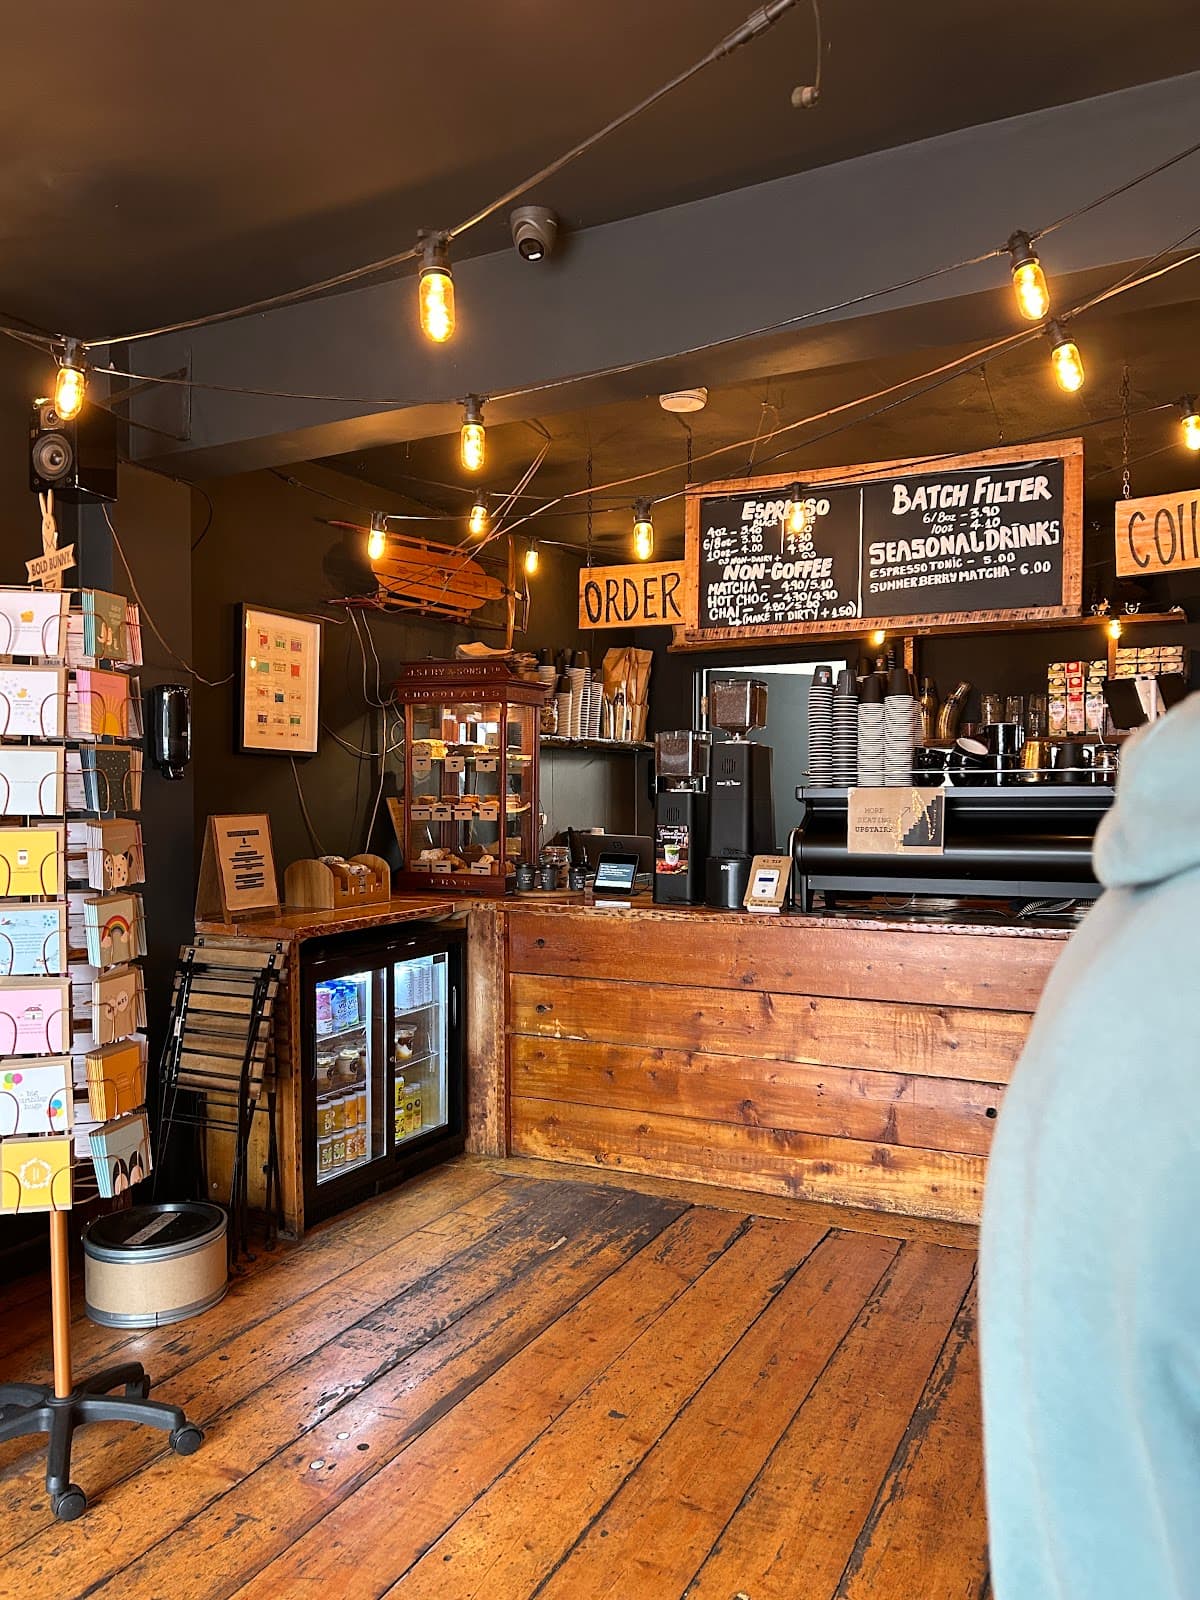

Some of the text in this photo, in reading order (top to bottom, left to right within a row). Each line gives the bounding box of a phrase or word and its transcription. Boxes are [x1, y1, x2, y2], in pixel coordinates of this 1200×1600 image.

[892, 475, 1053, 515] BATCH FILTER
[742, 499, 830, 520] ESPRESO
[741, 544, 763, 553] 4.00
[869, 520, 1060, 565] SEASONAL DRINKS
[31, 560, 48, 576] BOLD
[723, 557, 833, 580] NON-COFFEE
[870, 562, 928, 578] ESPRESSO
[929, 556, 963, 571] TONIC
[983, 552, 1016, 565] 5.00
[1020, 561, 1052, 575] 6.00
[708, 581, 758, 596] MATCHA
[585, 573, 681, 623] ORDER
[708, 594, 734, 608] HOT
[736, 592, 768, 606] CHOC
[709, 605, 740, 620] CHAI
[775, 612, 785, 621] IT
[787, 608, 818, 621] DIRTY
